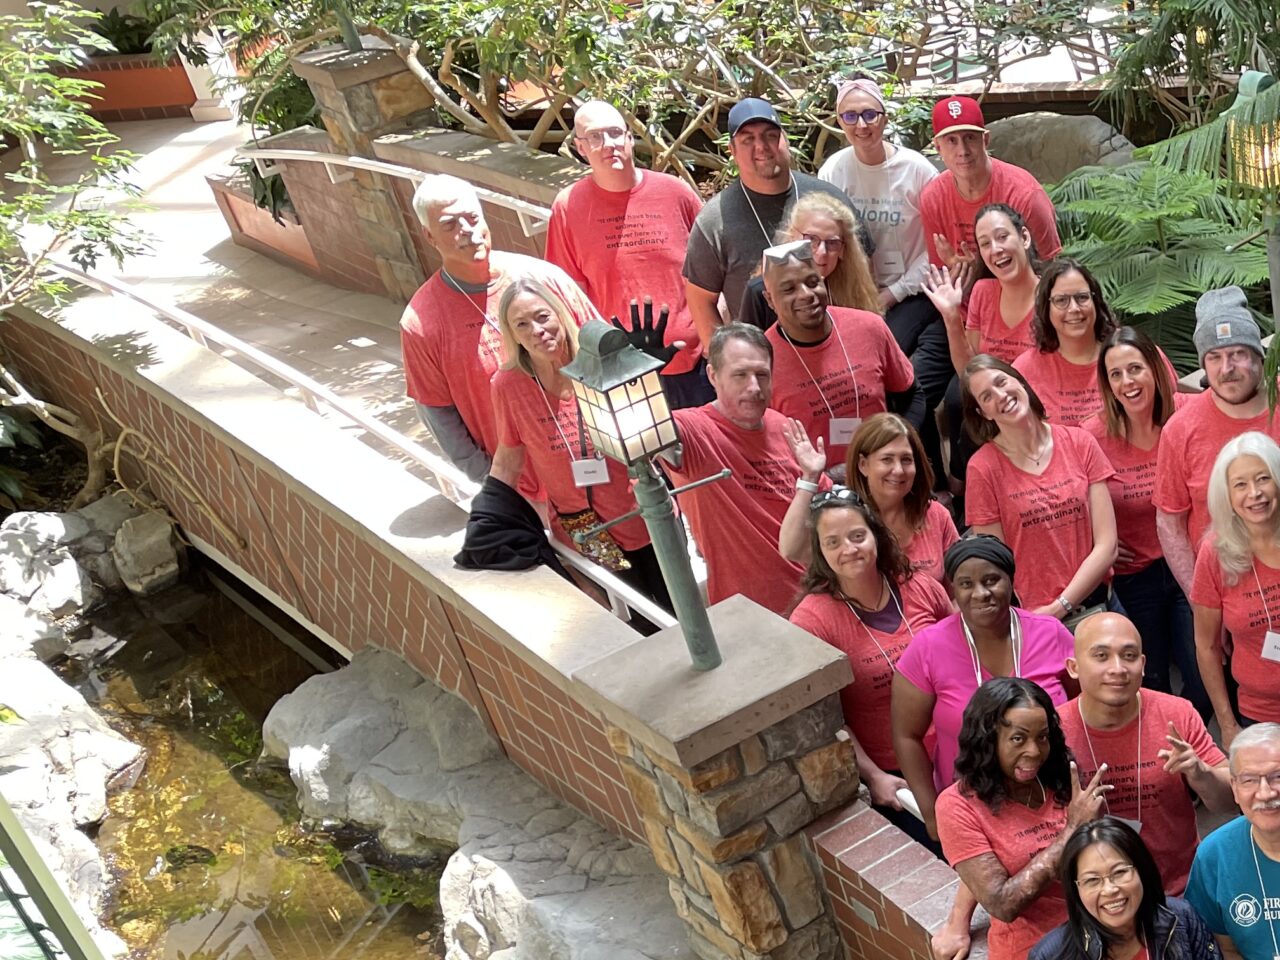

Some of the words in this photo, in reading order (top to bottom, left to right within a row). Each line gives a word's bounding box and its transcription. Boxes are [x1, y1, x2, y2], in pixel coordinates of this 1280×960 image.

[857, 206, 905, 227] long.
[1136, 472, 1156, 480] ordin
[1019, 510, 1032, 519] but
[1049, 501, 1067, 510] here
[1254, 584, 1277, 596] mght
[875, 647, 898, 660] mght
[1024, 823, 1046, 835] might
